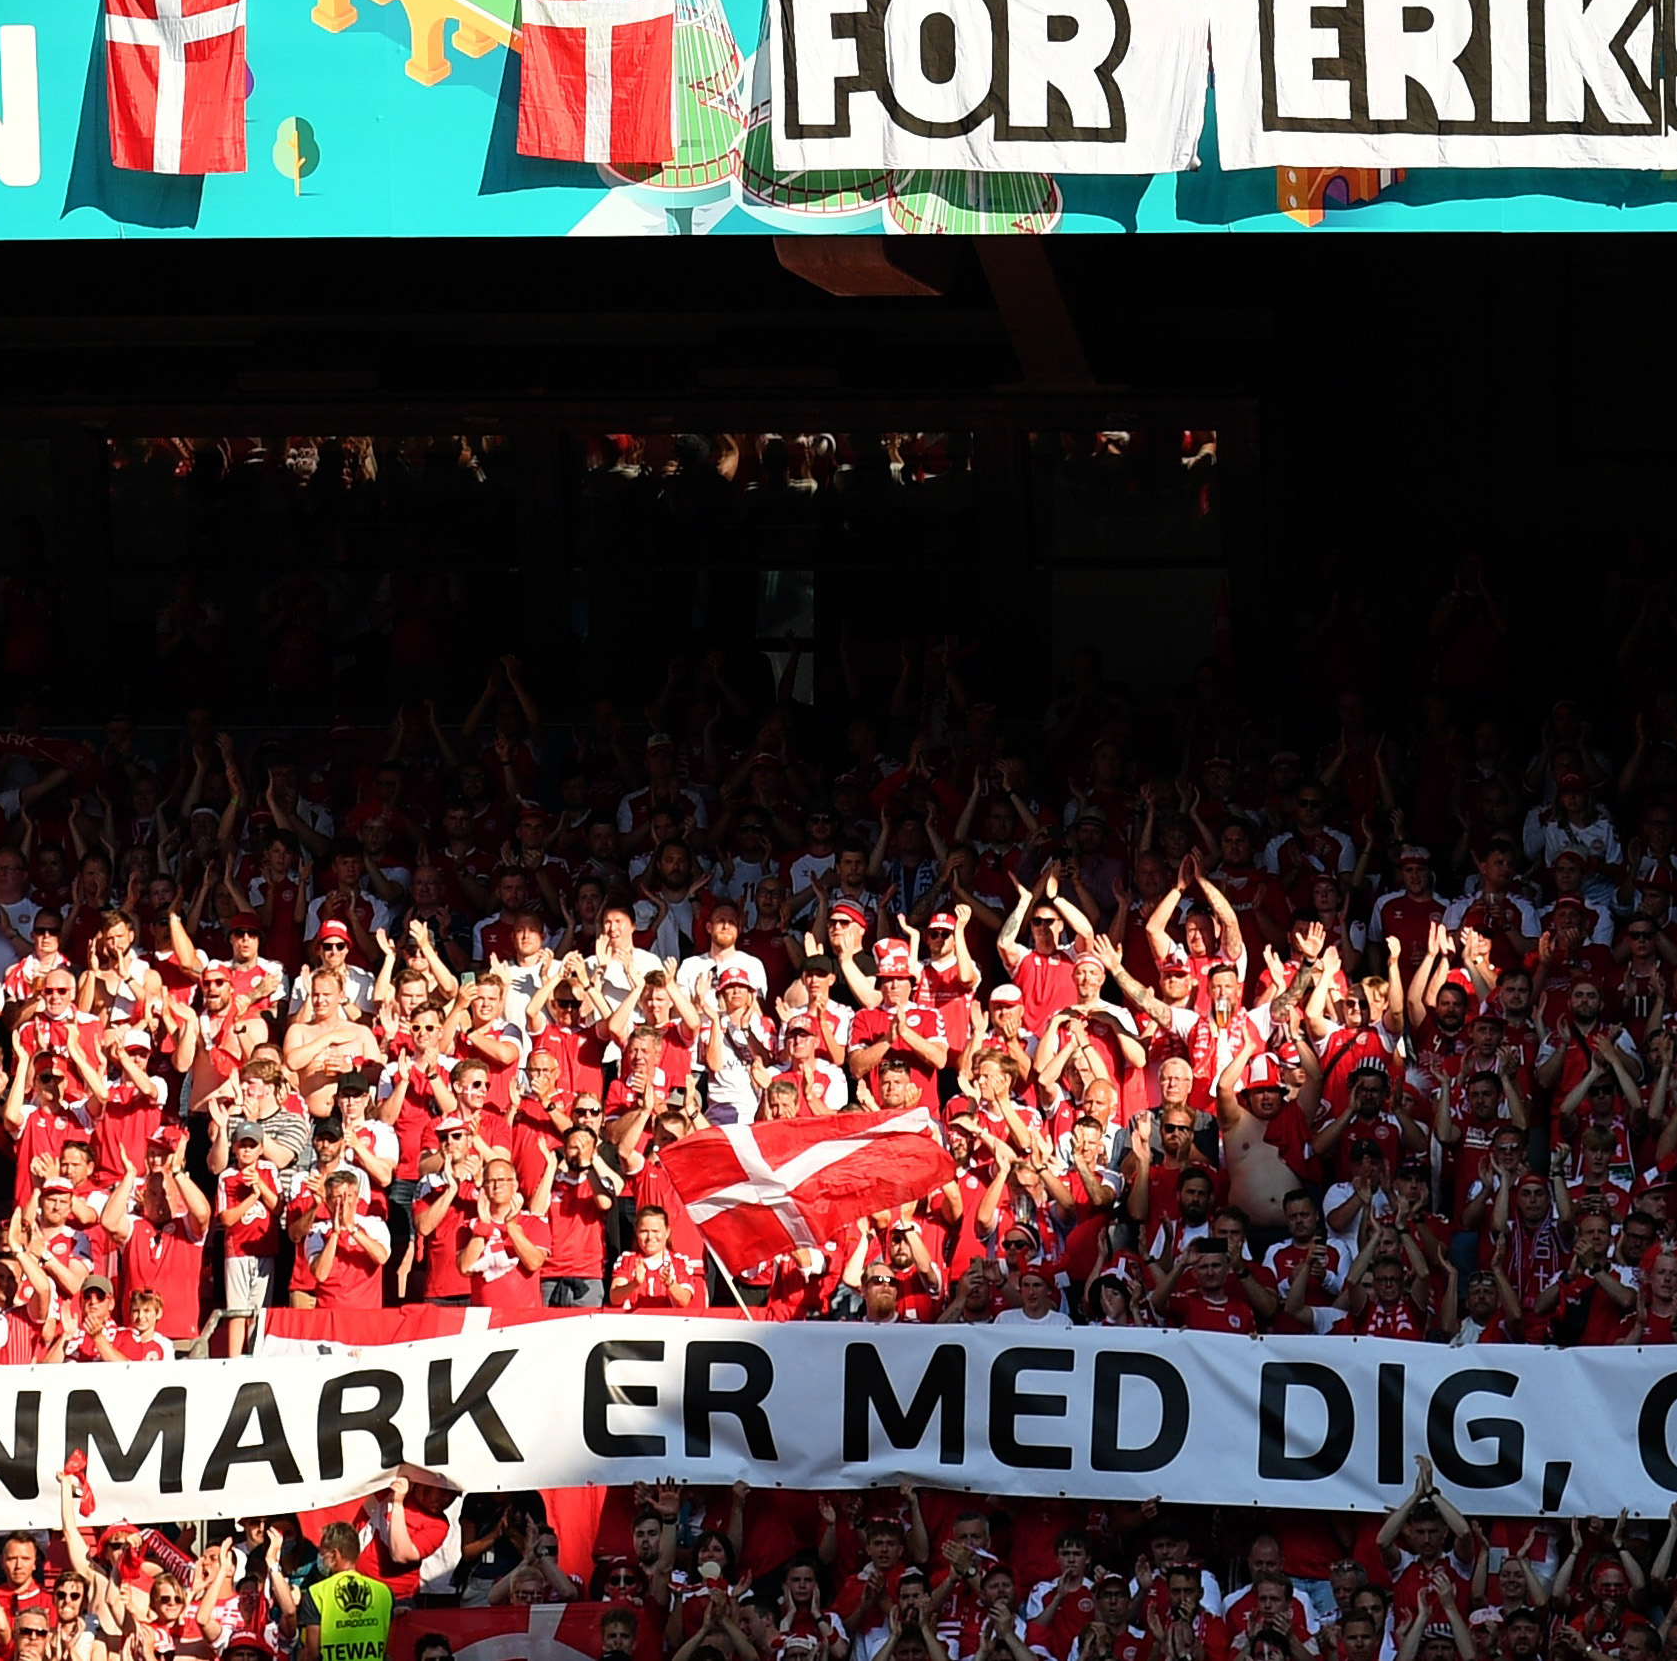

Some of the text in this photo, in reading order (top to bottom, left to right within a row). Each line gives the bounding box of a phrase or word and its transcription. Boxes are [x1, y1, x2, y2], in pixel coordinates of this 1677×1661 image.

[742, 882, 755, 903] 11
[1635, 995, 1647, 1018] 11
[584, 1341, 778, 1461] ER
[843, 1343, 1189, 1472] MED
[1259, 1363, 1571, 1515] DIG,
[319, 1642, 386, 1661] STEWAR
